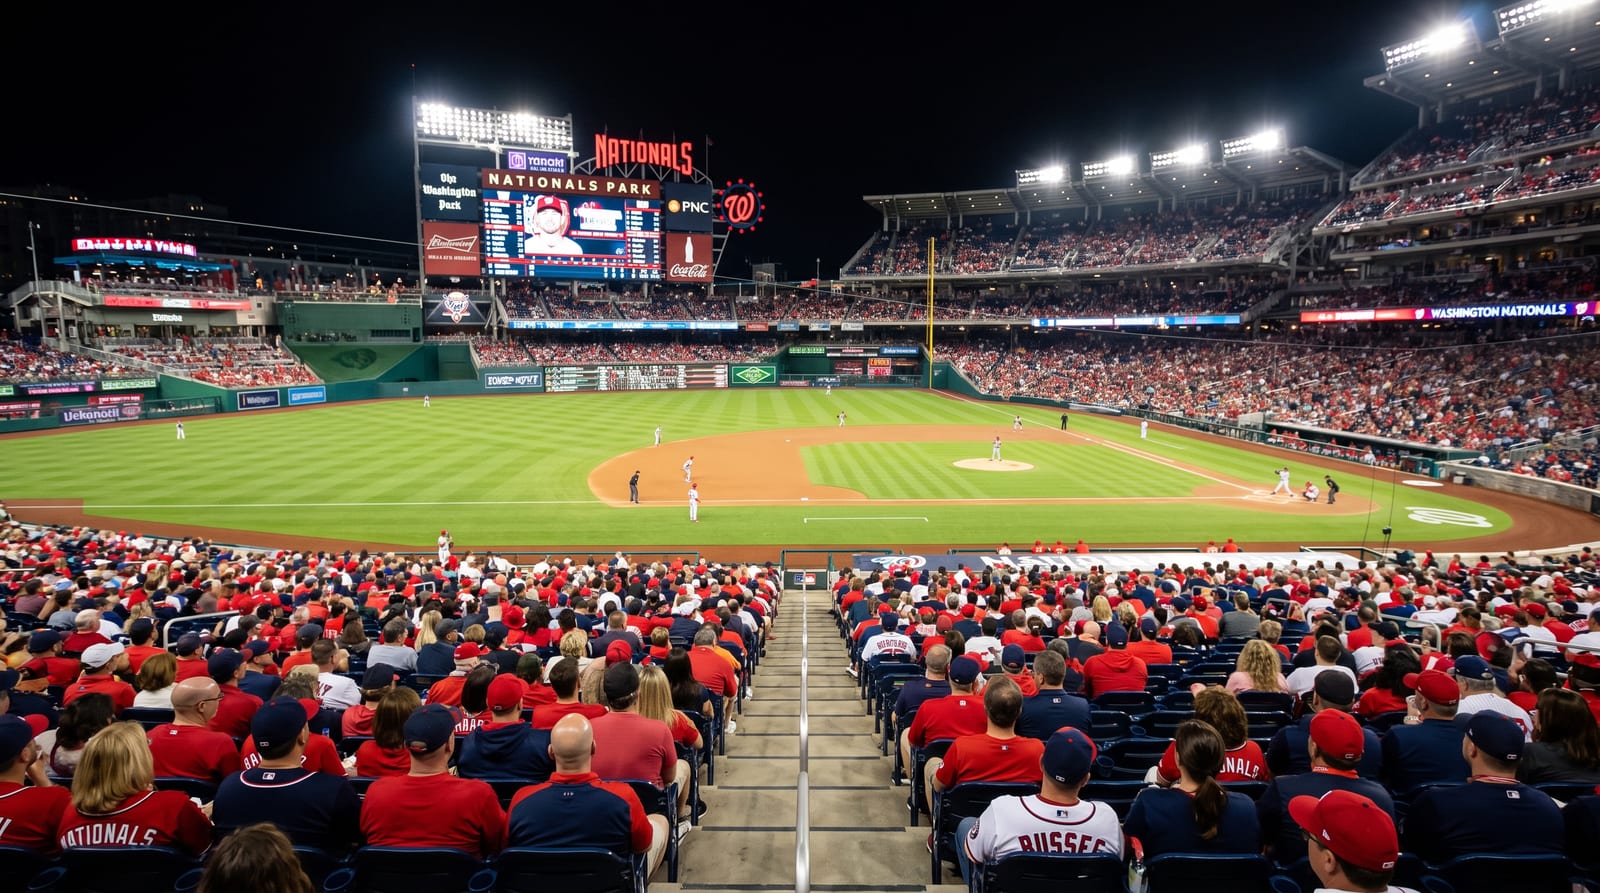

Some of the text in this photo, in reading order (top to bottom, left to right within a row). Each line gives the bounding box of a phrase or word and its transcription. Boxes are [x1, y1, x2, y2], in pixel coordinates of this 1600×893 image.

[595, 133, 692, 176] NATIONALS
[488, 172, 651, 195] NATIONALS PARK
[682, 201, 710, 214] PNC
[1431, 303, 1567, 319] WASHINGTON NATIONALS
